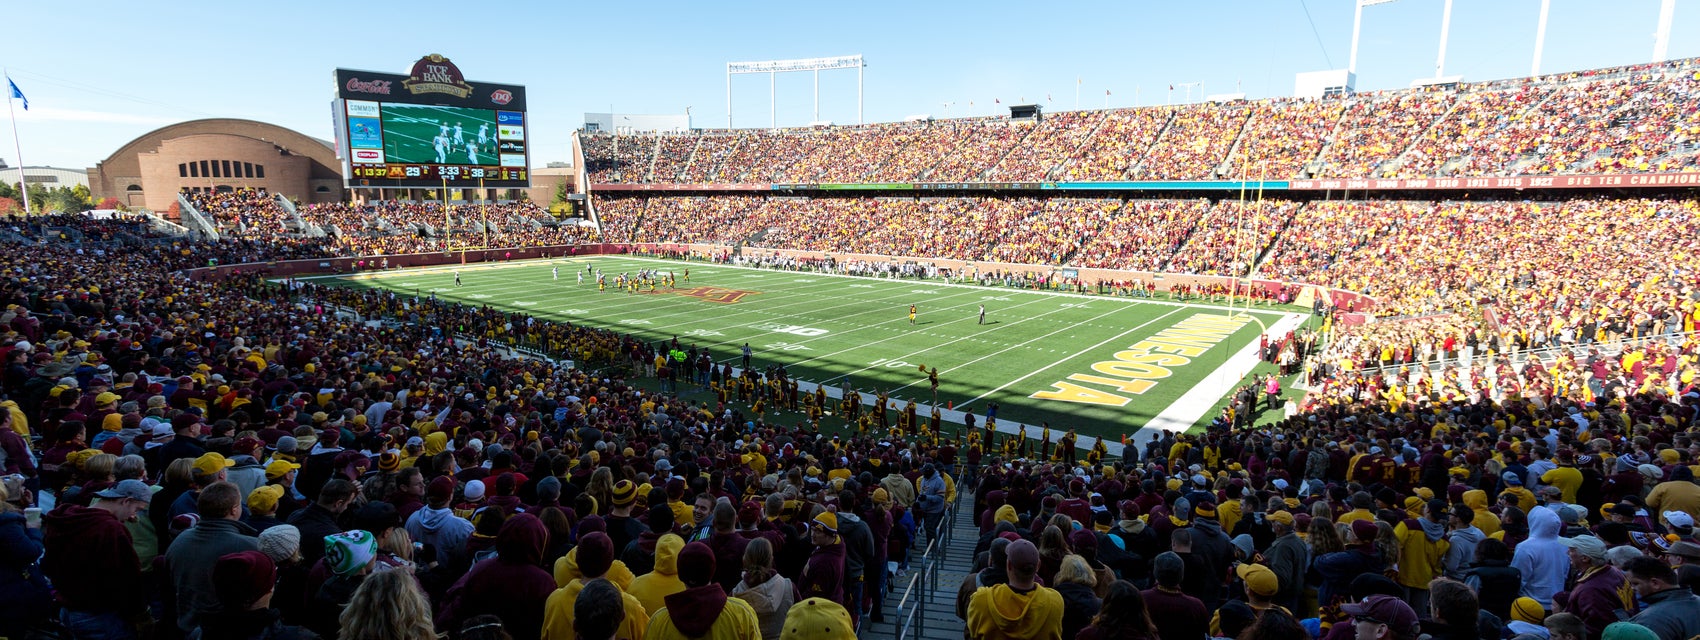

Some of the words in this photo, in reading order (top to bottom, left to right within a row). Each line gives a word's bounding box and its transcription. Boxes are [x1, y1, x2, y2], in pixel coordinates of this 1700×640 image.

[427, 64, 449, 76] TCF
[423, 72, 453, 83] BANK
[346, 77, 392, 95] Coca-Cola
[495, 92, 510, 101] DQ
[354, 168, 361, 176] 4
[365, 168, 374, 176] 13
[376, 168, 387, 176] 37
[406, 166, 420, 176] 29
[438, 166, 460, 175] 3:33
[471, 168, 484, 178] 38
[1293, 180, 1313, 189] 1900
[1435, 179, 1459, 188] 1910
[1466, 178, 1489, 187] 1911
[1497, 177, 1522, 187] 1915
[1529, 177, 1554, 187] 1927
[1567, 177, 1591, 186] BIG
[1600, 176, 1621, 185] TEN
[867, 358, 908, 368] 10
[1028, 313, 1254, 407] MINNESOTA
